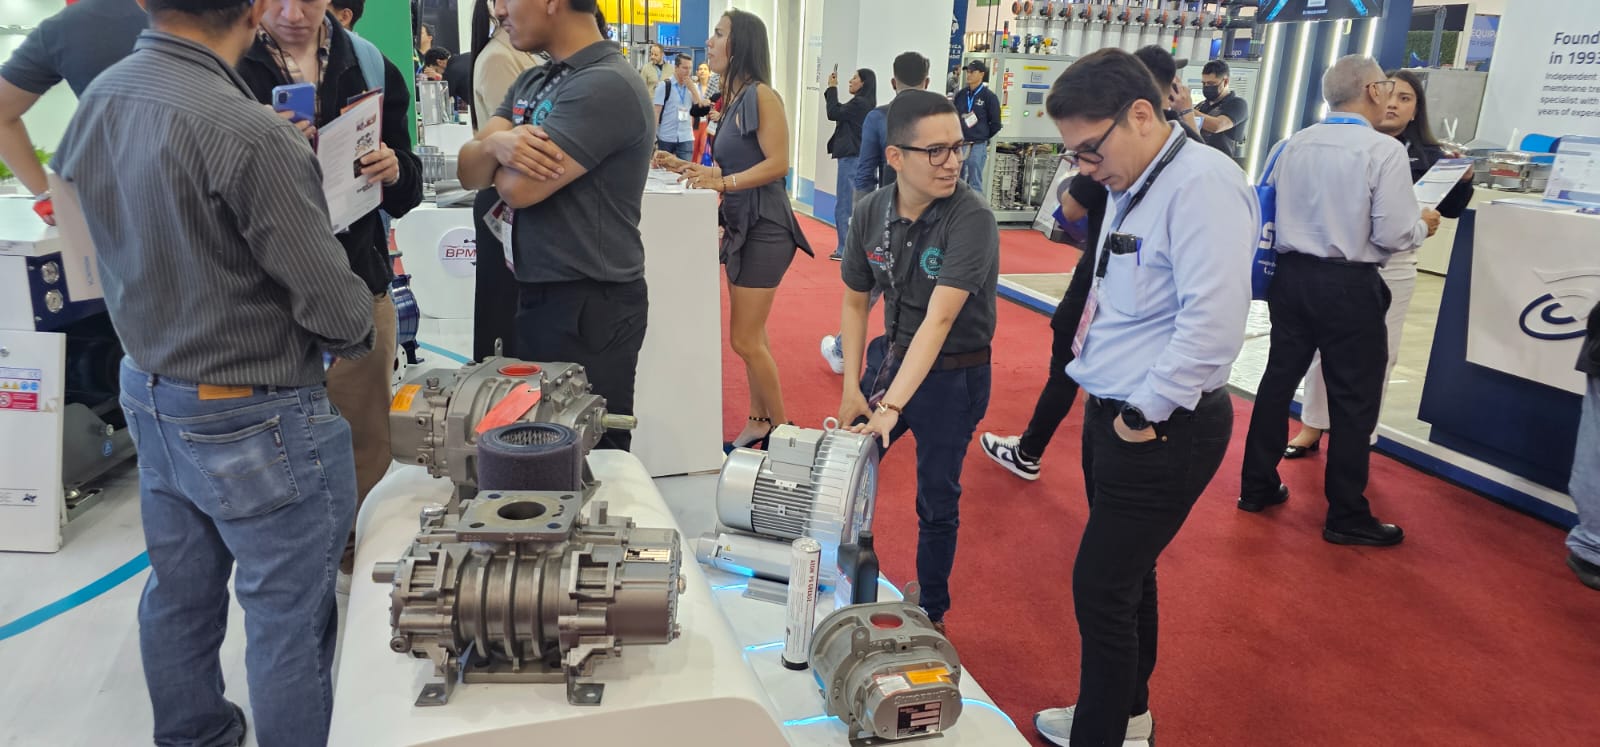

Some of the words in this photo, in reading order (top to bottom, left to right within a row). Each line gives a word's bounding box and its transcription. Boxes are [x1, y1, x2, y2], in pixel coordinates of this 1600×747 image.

[1548, 51, 1563, 65] in
[1545, 72, 1598, 81] Independent
[1542, 84, 1587, 92] membrane
[1540, 96, 1578, 105] specialist
[1537, 108, 1560, 117] years
[1560, 108, 1571, 116] of
